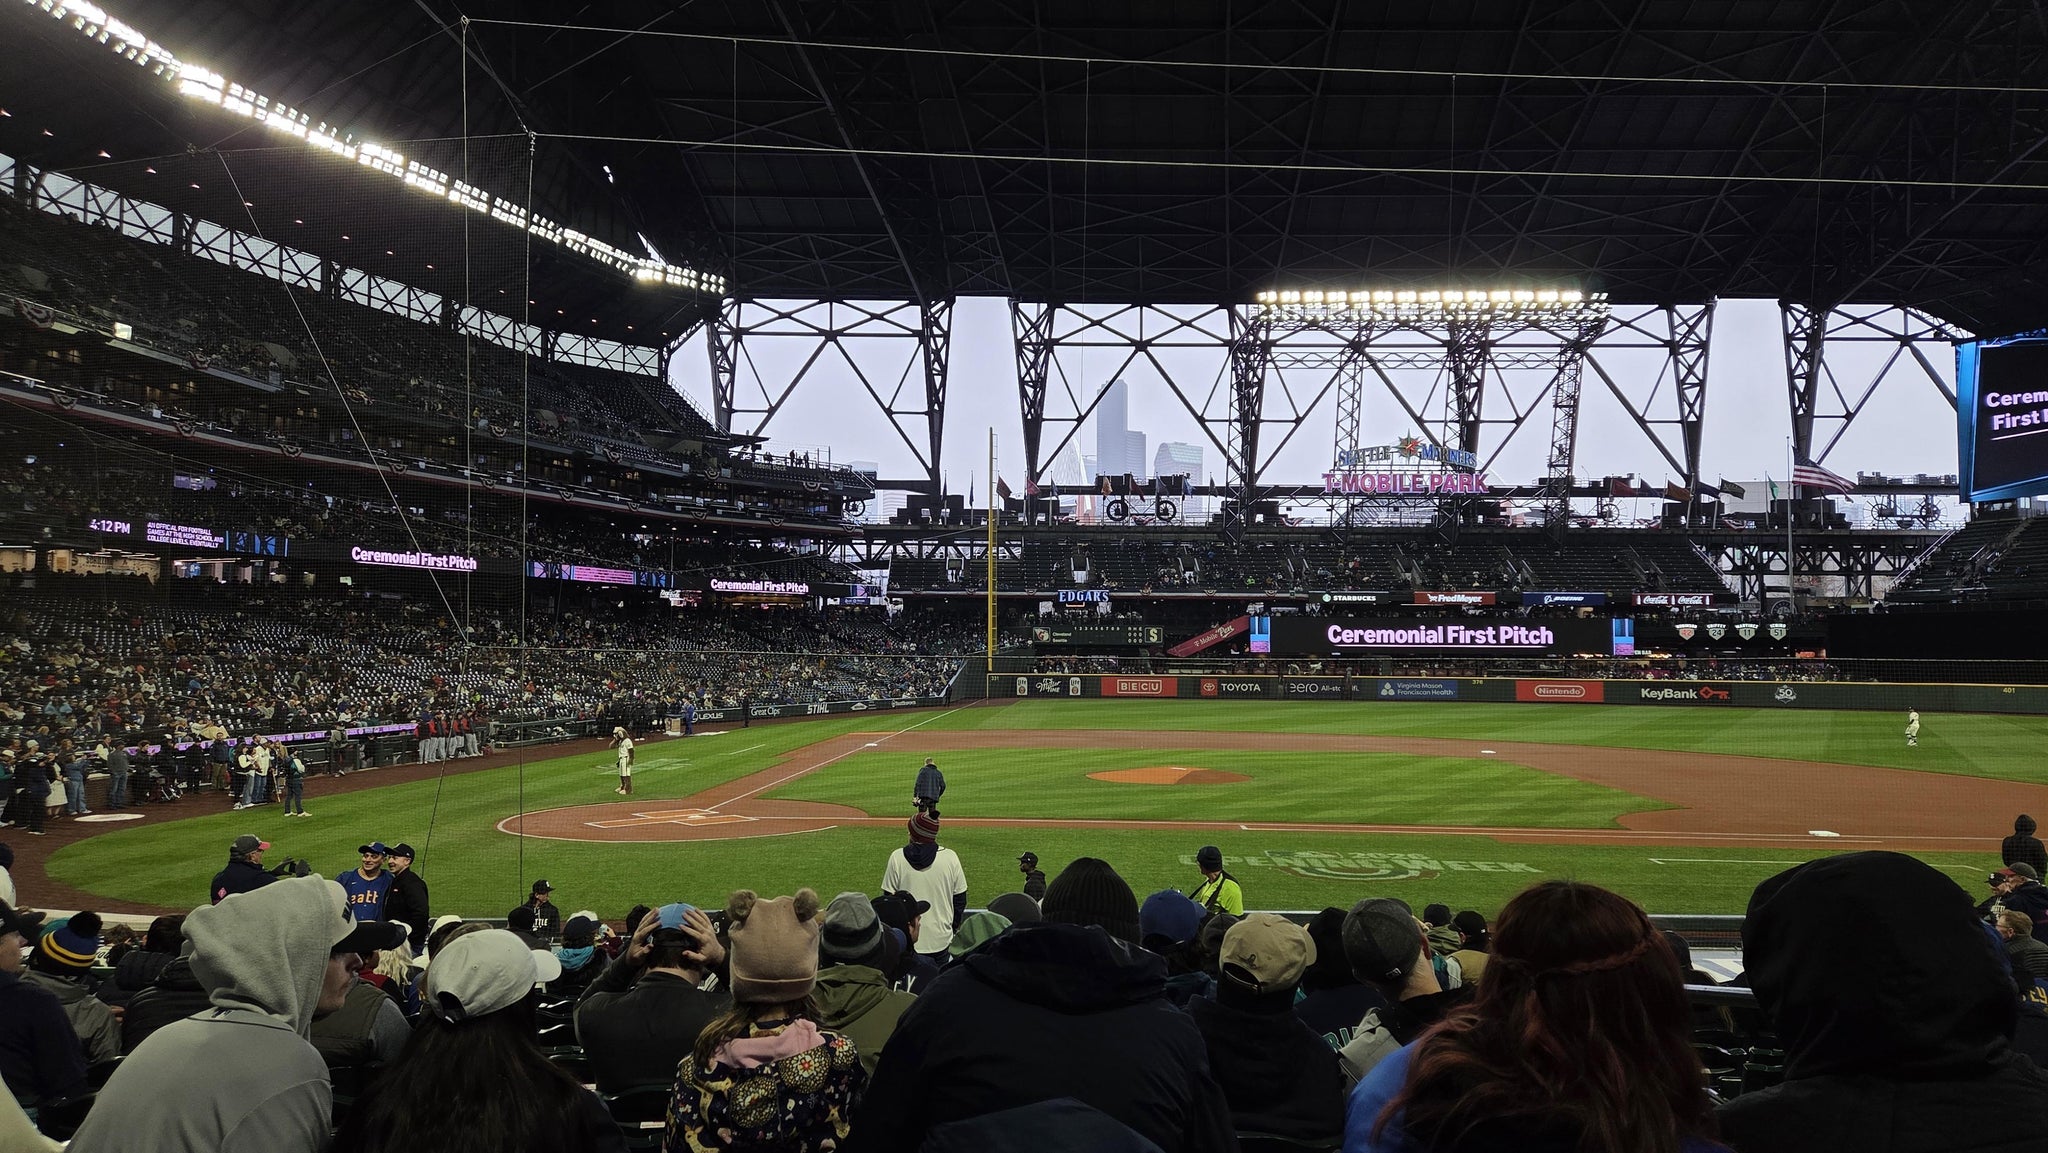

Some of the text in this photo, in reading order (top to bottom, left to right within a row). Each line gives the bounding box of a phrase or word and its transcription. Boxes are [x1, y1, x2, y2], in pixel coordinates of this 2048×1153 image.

[1993, 411, 2040, 430] First
[1338, 443, 1477, 468] SEATTLE MARINERS
[1322, 472, 1490, 493] T-MOBILE PARK
[89, 519, 131, 534] 4:12 PM
[178, 525, 188, 533] FOR
[188, 527, 212, 536] FOOTBALL
[147, 535, 170, 544] COLLEGE
[190, 540, 219, 549] EVENTUALLY
[195, 534, 213, 543] SCHOOL
[352, 546, 477, 570] Ceremonial First Pitch
[711, 578, 809, 593] Ceremonial First Pitch
[1059, 590, 1110, 602] EDGARS
[1149, 628, 1158, 643] S
[1199, 633, 1218, 645] Mobile
[1216, 625, 1235, 639] Pen
[1328, 624, 1554, 644] Ceremonial First Pitch
[1120, 682, 1159, 691] BECU
[1221, 683, 1261, 692] TOYOTA
[1538, 687, 1581, 695] Nintendo
[1779, 689, 1793, 697] 50
[1641, 687, 1698, 700] KeyBank
[750, 706, 781, 717] Great Clips
[807, 703, 830, 714] STIHL
[698, 712, 724, 720] LEXUS
[1390, 859, 1545, 873] WEEK
